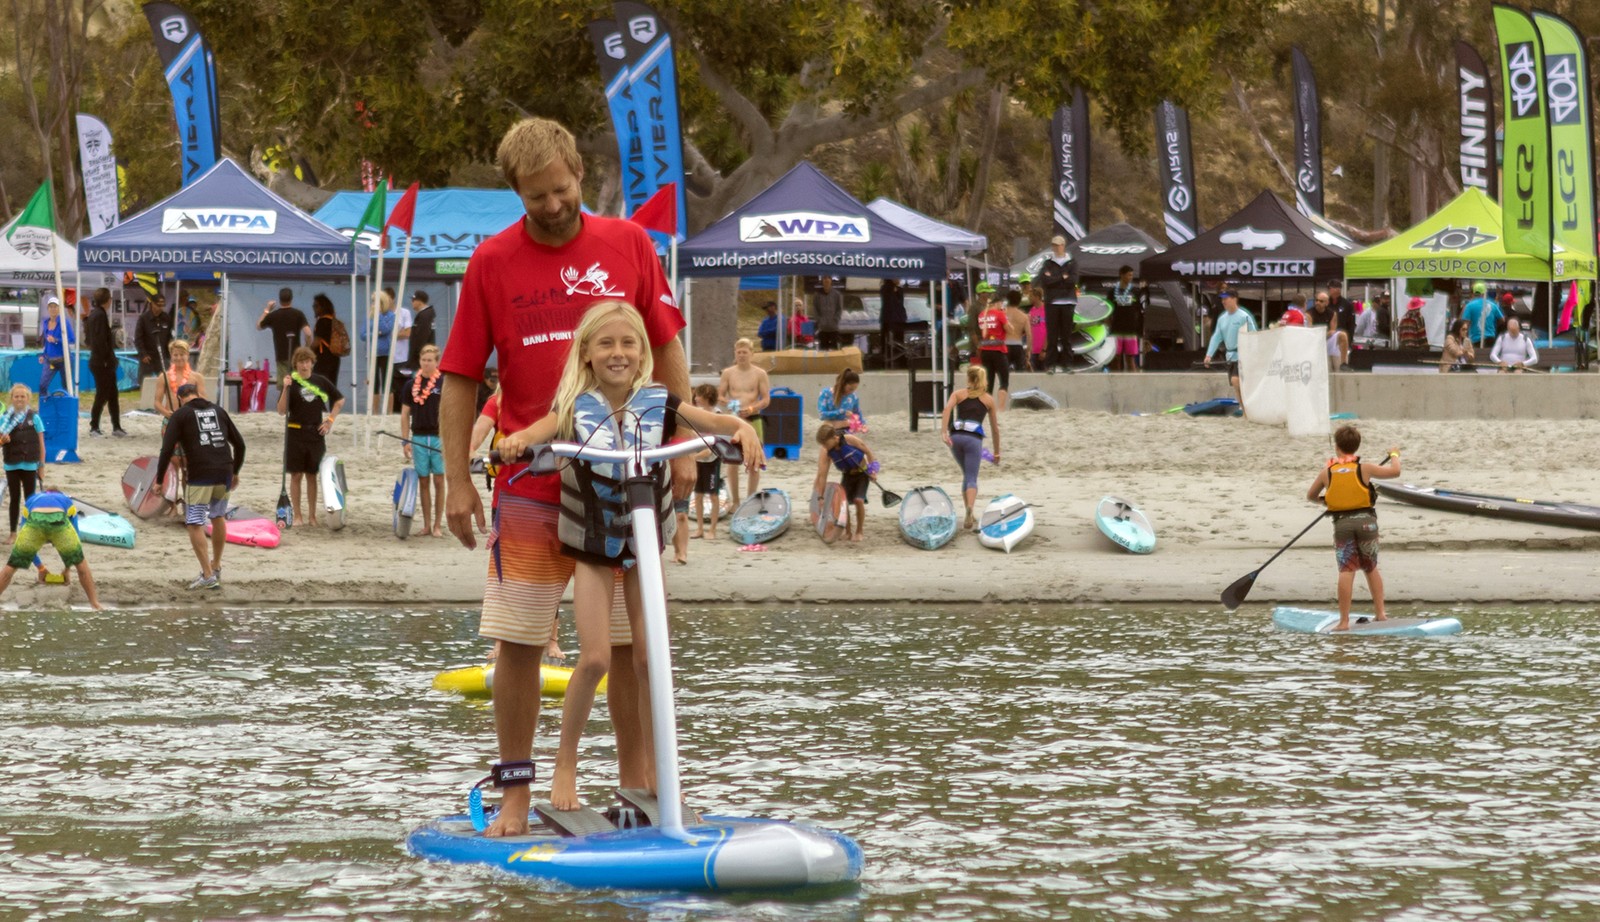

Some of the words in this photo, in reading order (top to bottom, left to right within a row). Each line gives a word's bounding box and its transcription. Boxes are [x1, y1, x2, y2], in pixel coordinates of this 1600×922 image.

[197, 214, 270, 229] WPA
[778, 219, 863, 237] WPA
[84, 250, 348, 265] WORLDPADDLEASSOCIATION.COM
[692, 252, 924, 269] worldpaddlesassociation.com
[1197, 262, 1251, 275] HIPPO
[1256, 262, 1311, 275] STICK
[1392, 259, 1507, 274] 404SUP.COM
[523, 335, 548, 346] DANA
[549, 332, 571, 341] POINT
